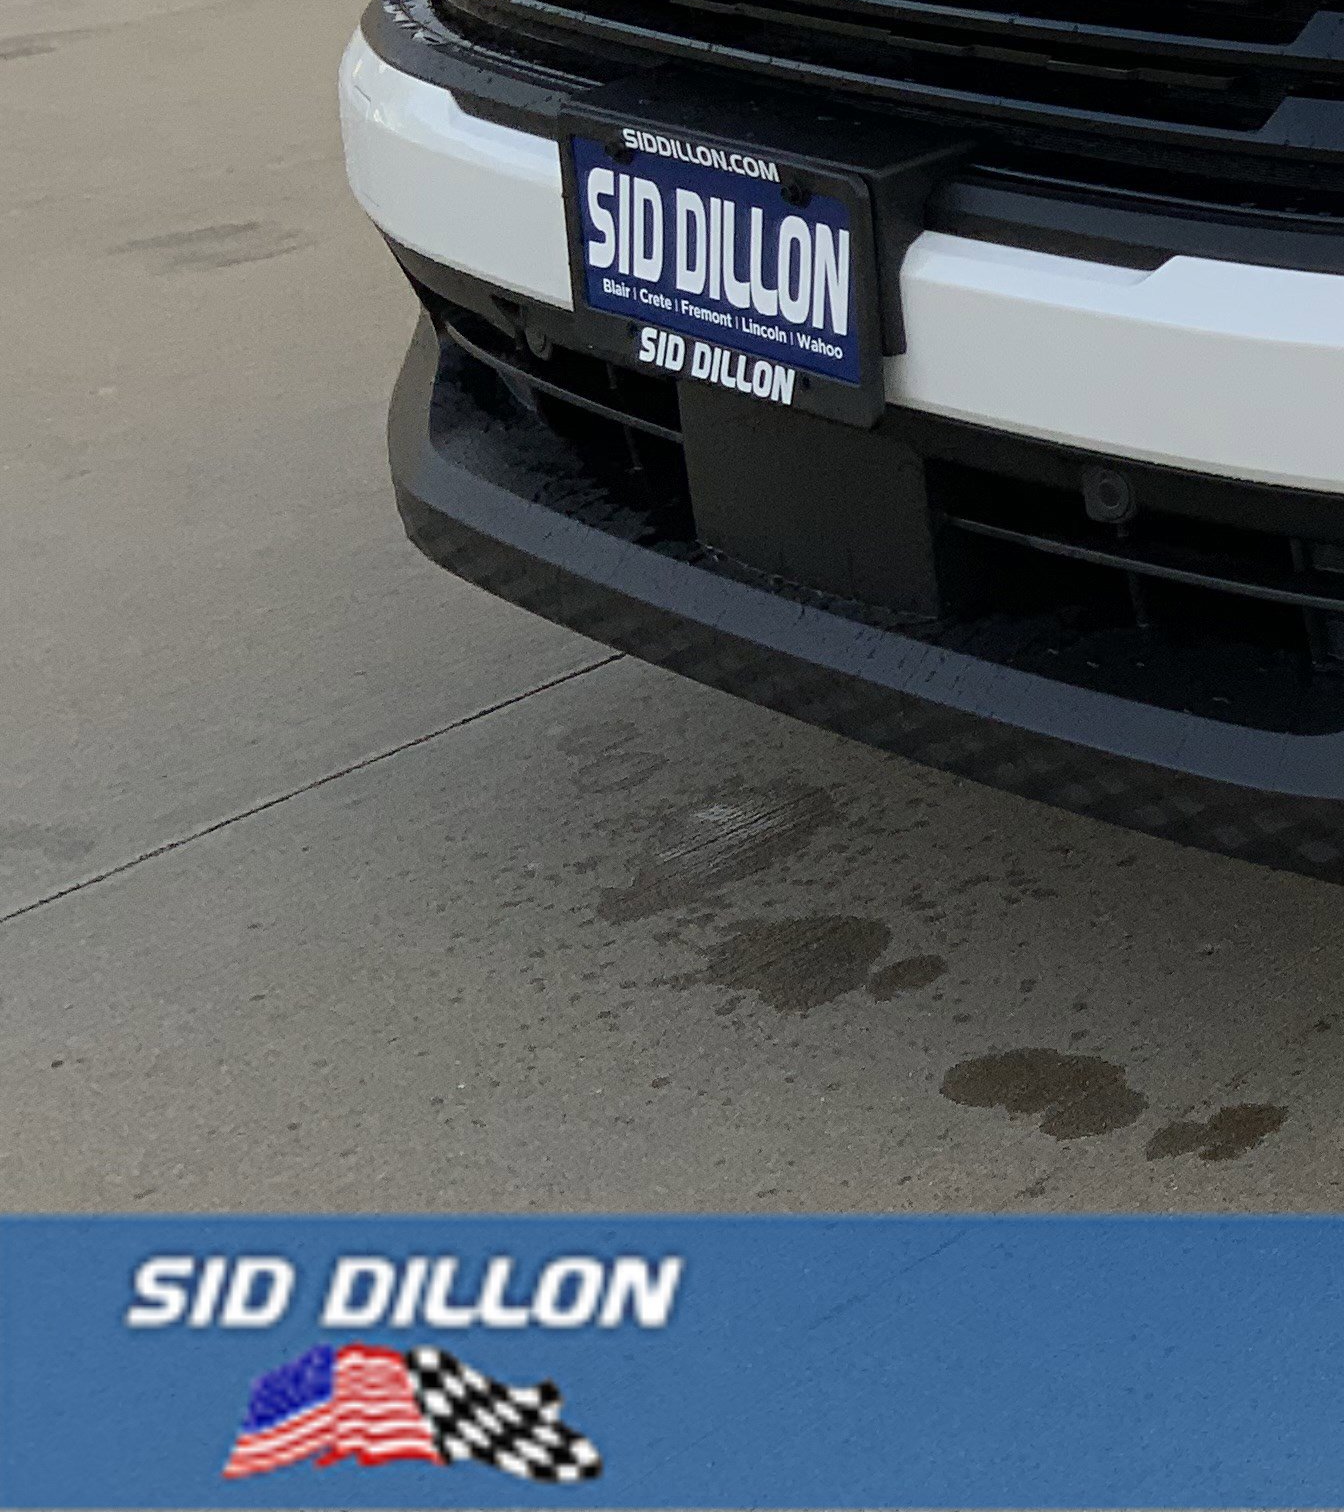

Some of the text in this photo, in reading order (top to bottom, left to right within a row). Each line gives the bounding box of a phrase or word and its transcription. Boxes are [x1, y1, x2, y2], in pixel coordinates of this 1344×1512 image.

[622, 127, 781, 183] SIDDILLON.COM
[586, 166, 850, 337] SID DILLON
[603, 277, 844, 361] Blair Crete Fremont Lincoln Wahoo
[638, 326, 797, 407] SID DILLON
